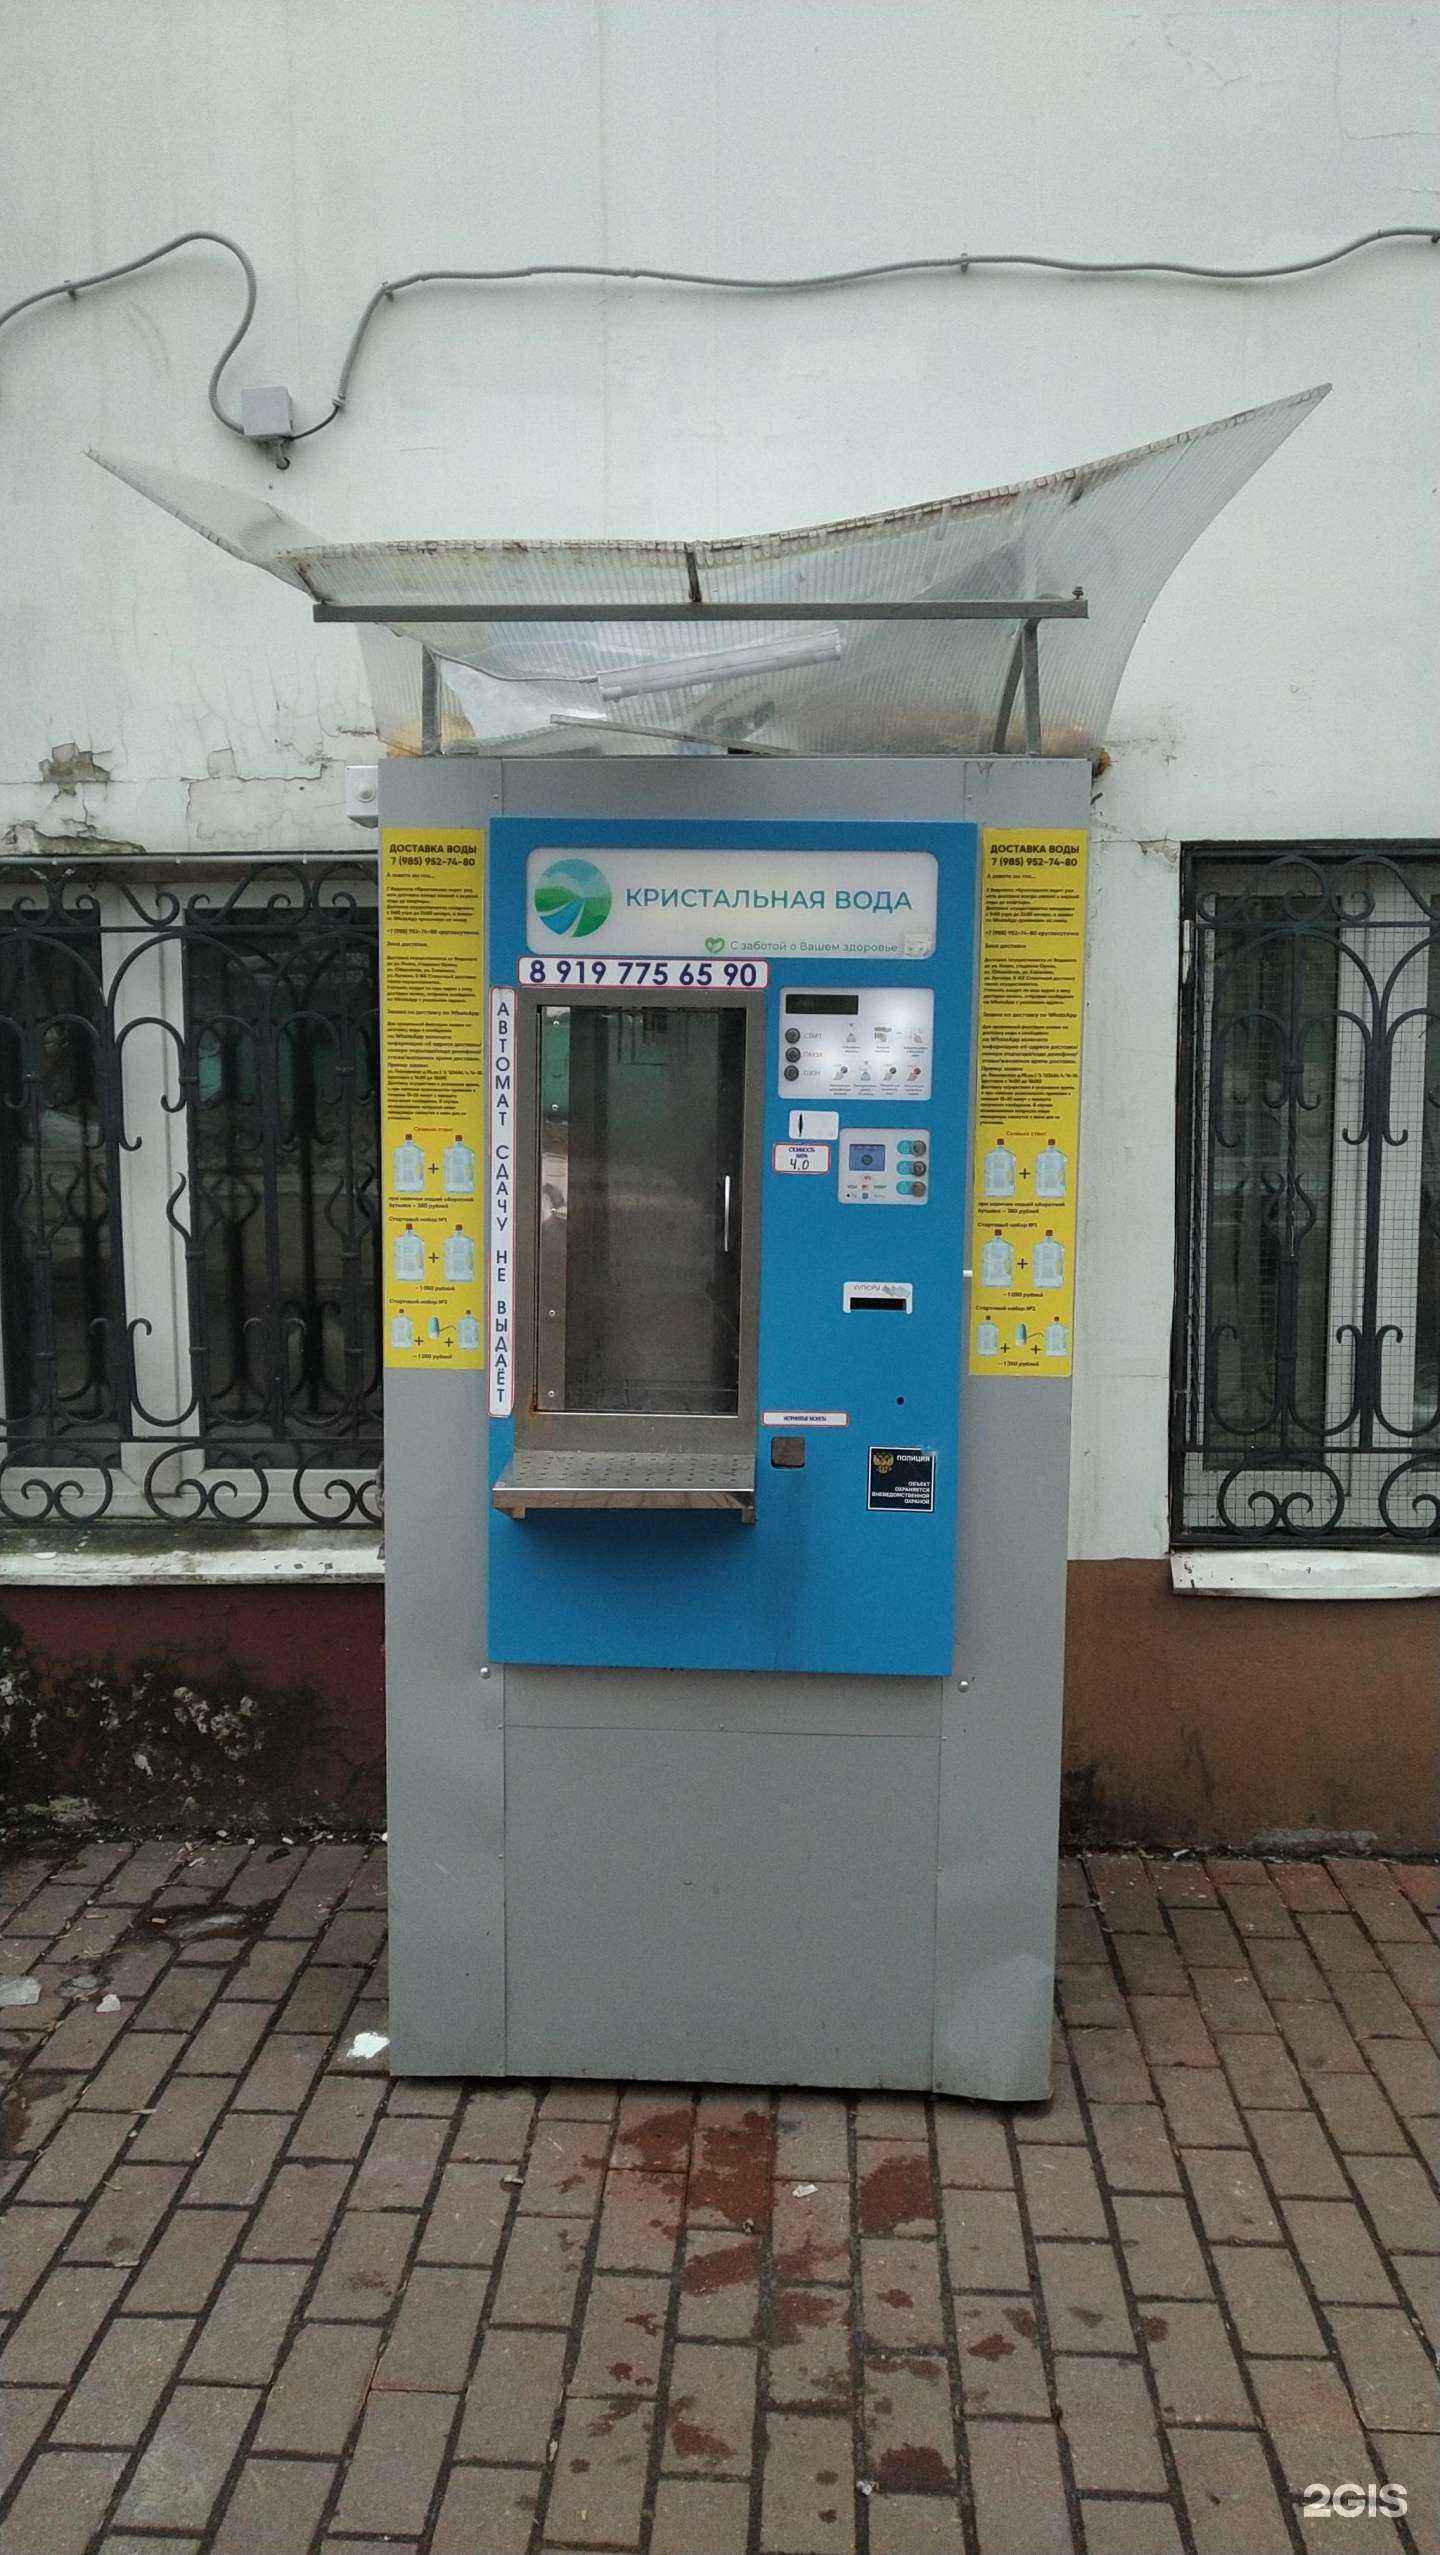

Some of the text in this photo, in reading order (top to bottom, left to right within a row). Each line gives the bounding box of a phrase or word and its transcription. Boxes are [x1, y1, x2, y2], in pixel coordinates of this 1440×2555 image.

[389, 843, 477, 854] ДОСТАВКА ВОДЫ
[990, 844, 1080, 855] ДОСТАВКА ВОДЫ
[391, 856, 476, 867] 7 (985) 952-74-80
[991, 857, 1078, 867] 7 (985) 952-74-80
[625, 888, 913, 914] КРИСТАЛЬНАЯ ВОДА
[729, 940, 898, 954] С заботой о Вашем здоровье
[529, 959, 758, 987] 8 919 775 65 90
[494, 1001, 511, 1403] АВТОМАТ СДАЧУ НЕ ВЫДАЁТ
[896, 1454, 930, 1463] ПОЛИЦИЯ
